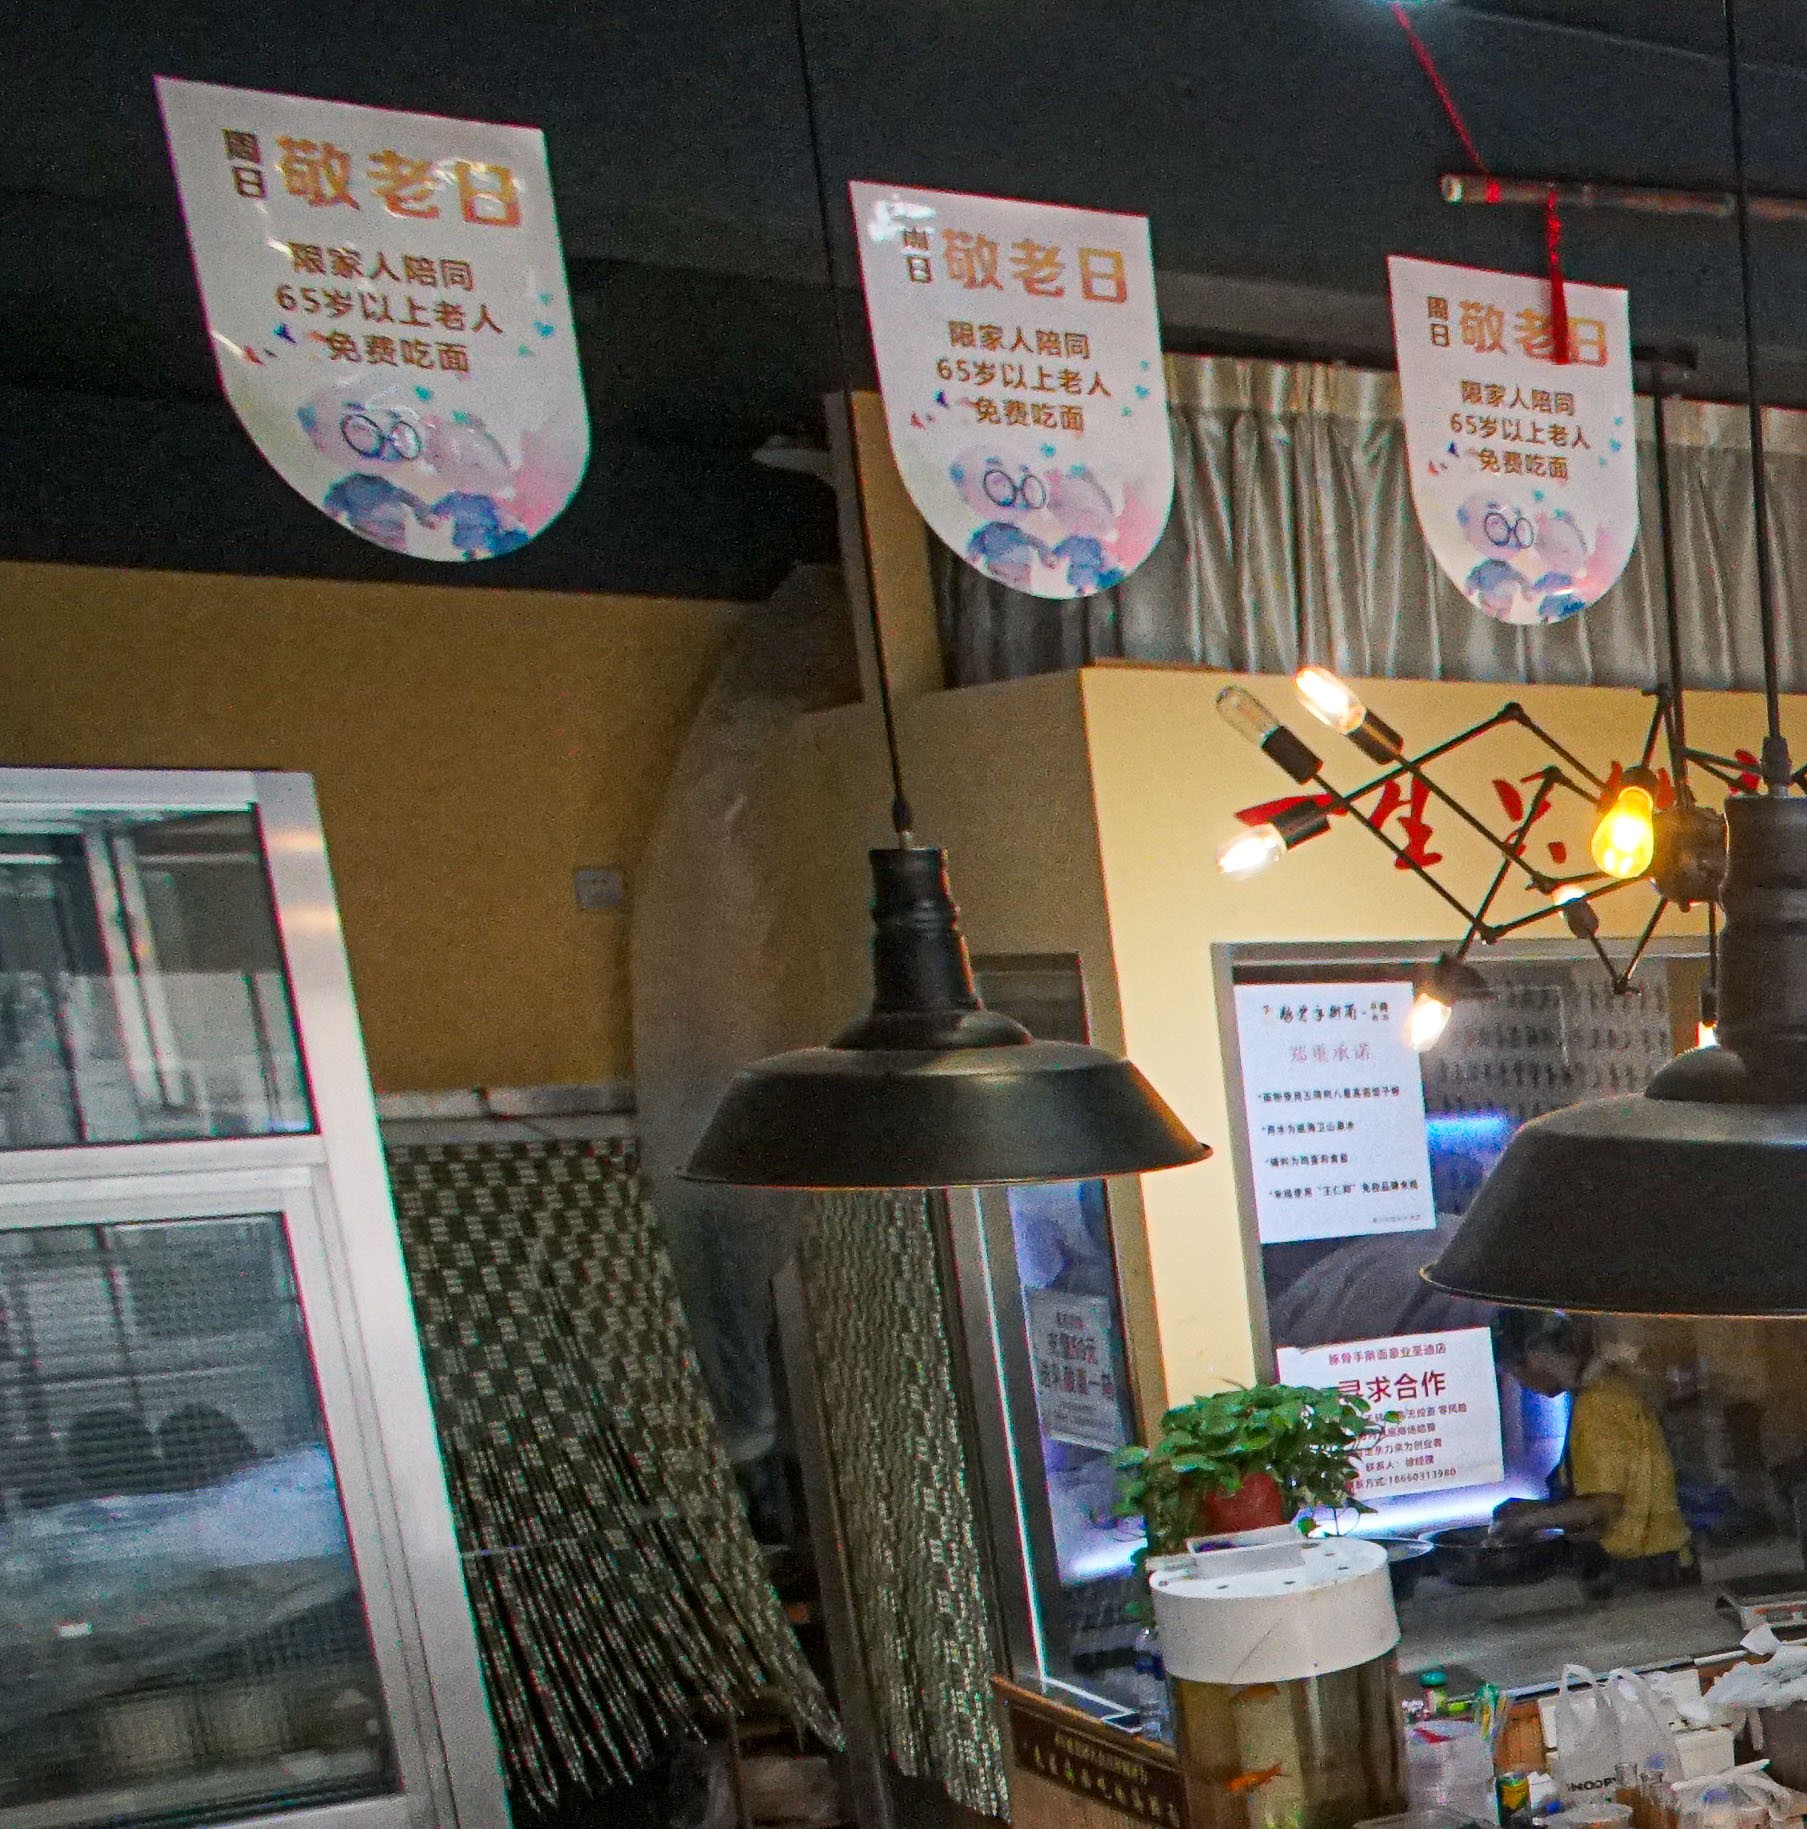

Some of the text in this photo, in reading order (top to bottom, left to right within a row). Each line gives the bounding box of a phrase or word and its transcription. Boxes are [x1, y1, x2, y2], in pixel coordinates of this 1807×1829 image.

[276, 136, 522, 228] 敬老日
[289, 242, 475, 294] 限家人陪同
[942, 228, 1129, 305] 敬老日
[276, 284, 503, 336] 65岁以上老人
[325, 329, 470, 374] 免费吃面
[947, 320, 1091, 361] 限家人陪同
[1459, 301, 1608, 368] 敬老日
[936, 356, 1112, 399] 65岁以上老人
[1460, 380, 1576, 416] 限家人陪同
[973, 395, 1086, 432] 免费吃面
[1450, 413, 1591, 450] 65岁以上老人
[1479, 447, 1569, 481] 免费吃面
